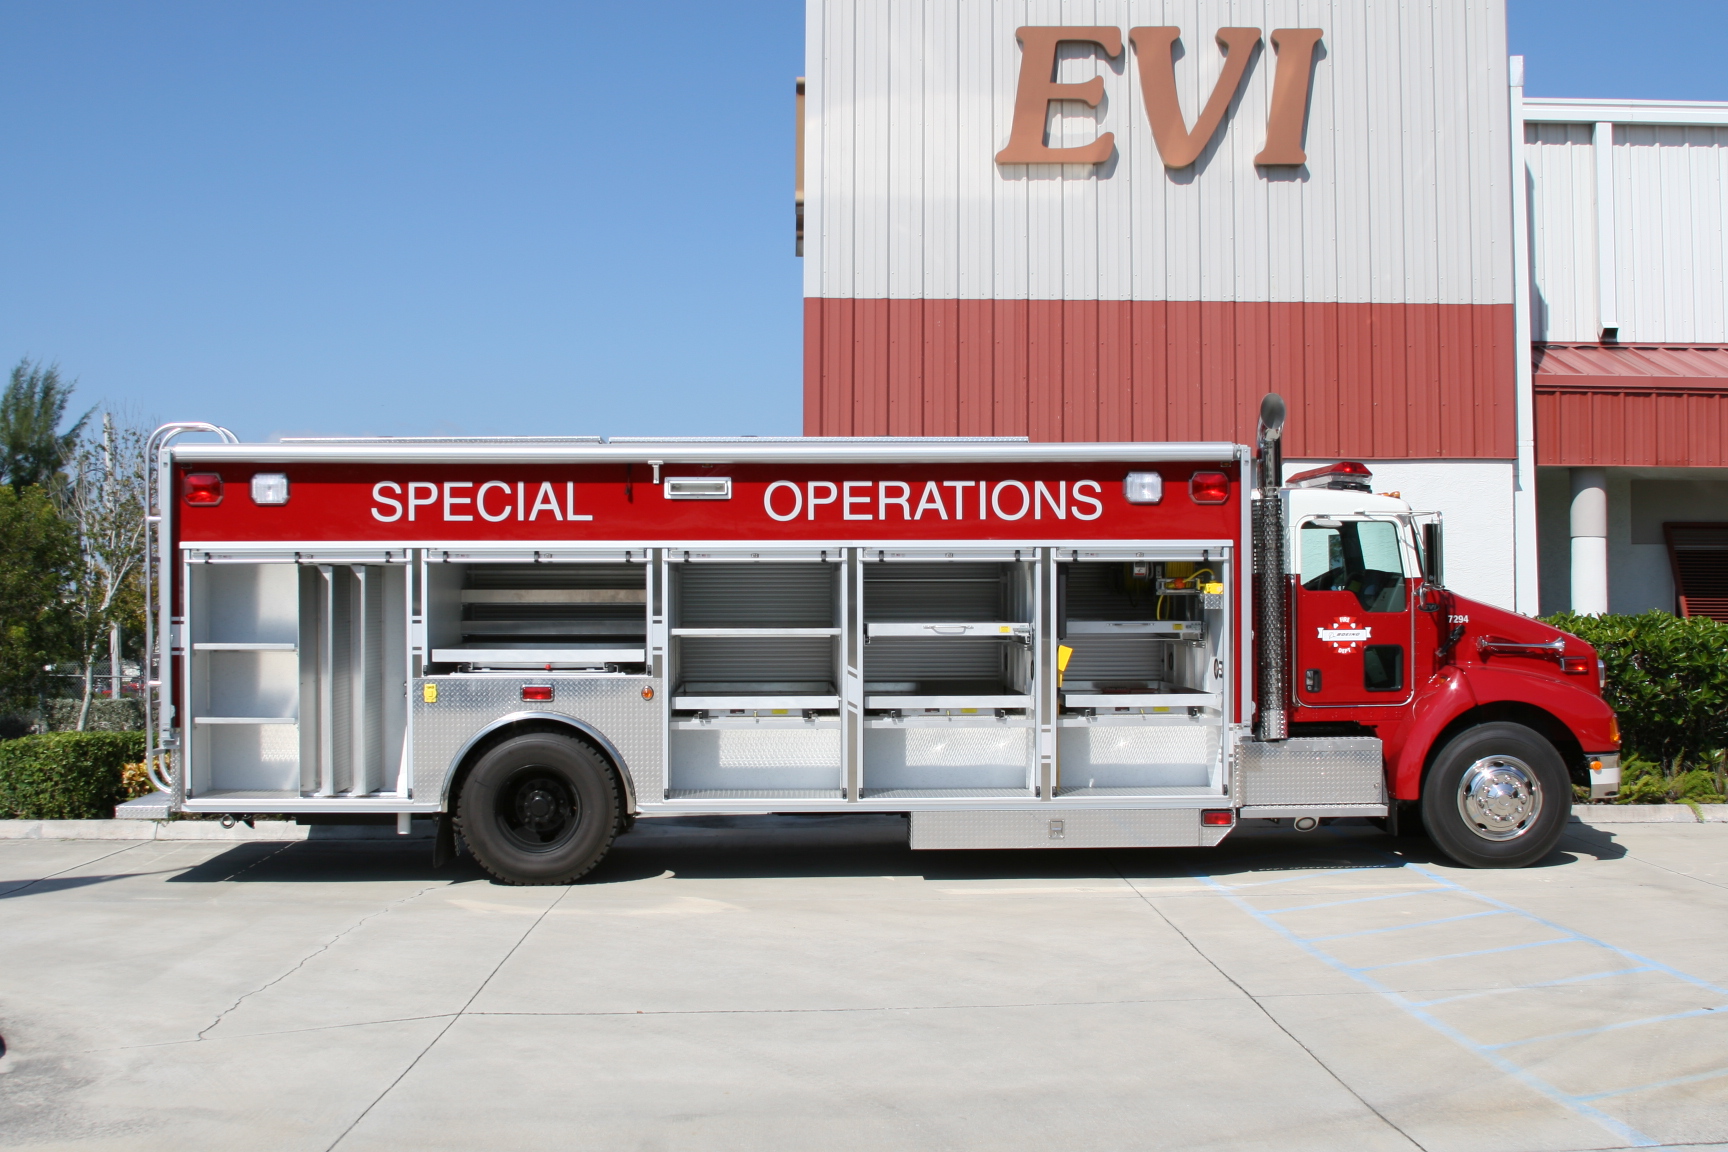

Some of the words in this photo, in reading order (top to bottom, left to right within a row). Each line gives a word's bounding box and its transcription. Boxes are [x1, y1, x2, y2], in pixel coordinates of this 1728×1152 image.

[995, 26, 1323, 169] EVI
[370, 480, 594, 523] SPECIAL
[763, 479, 1103, 522] OPERATIONS
[1447, 614, 1469, 624] 7294
